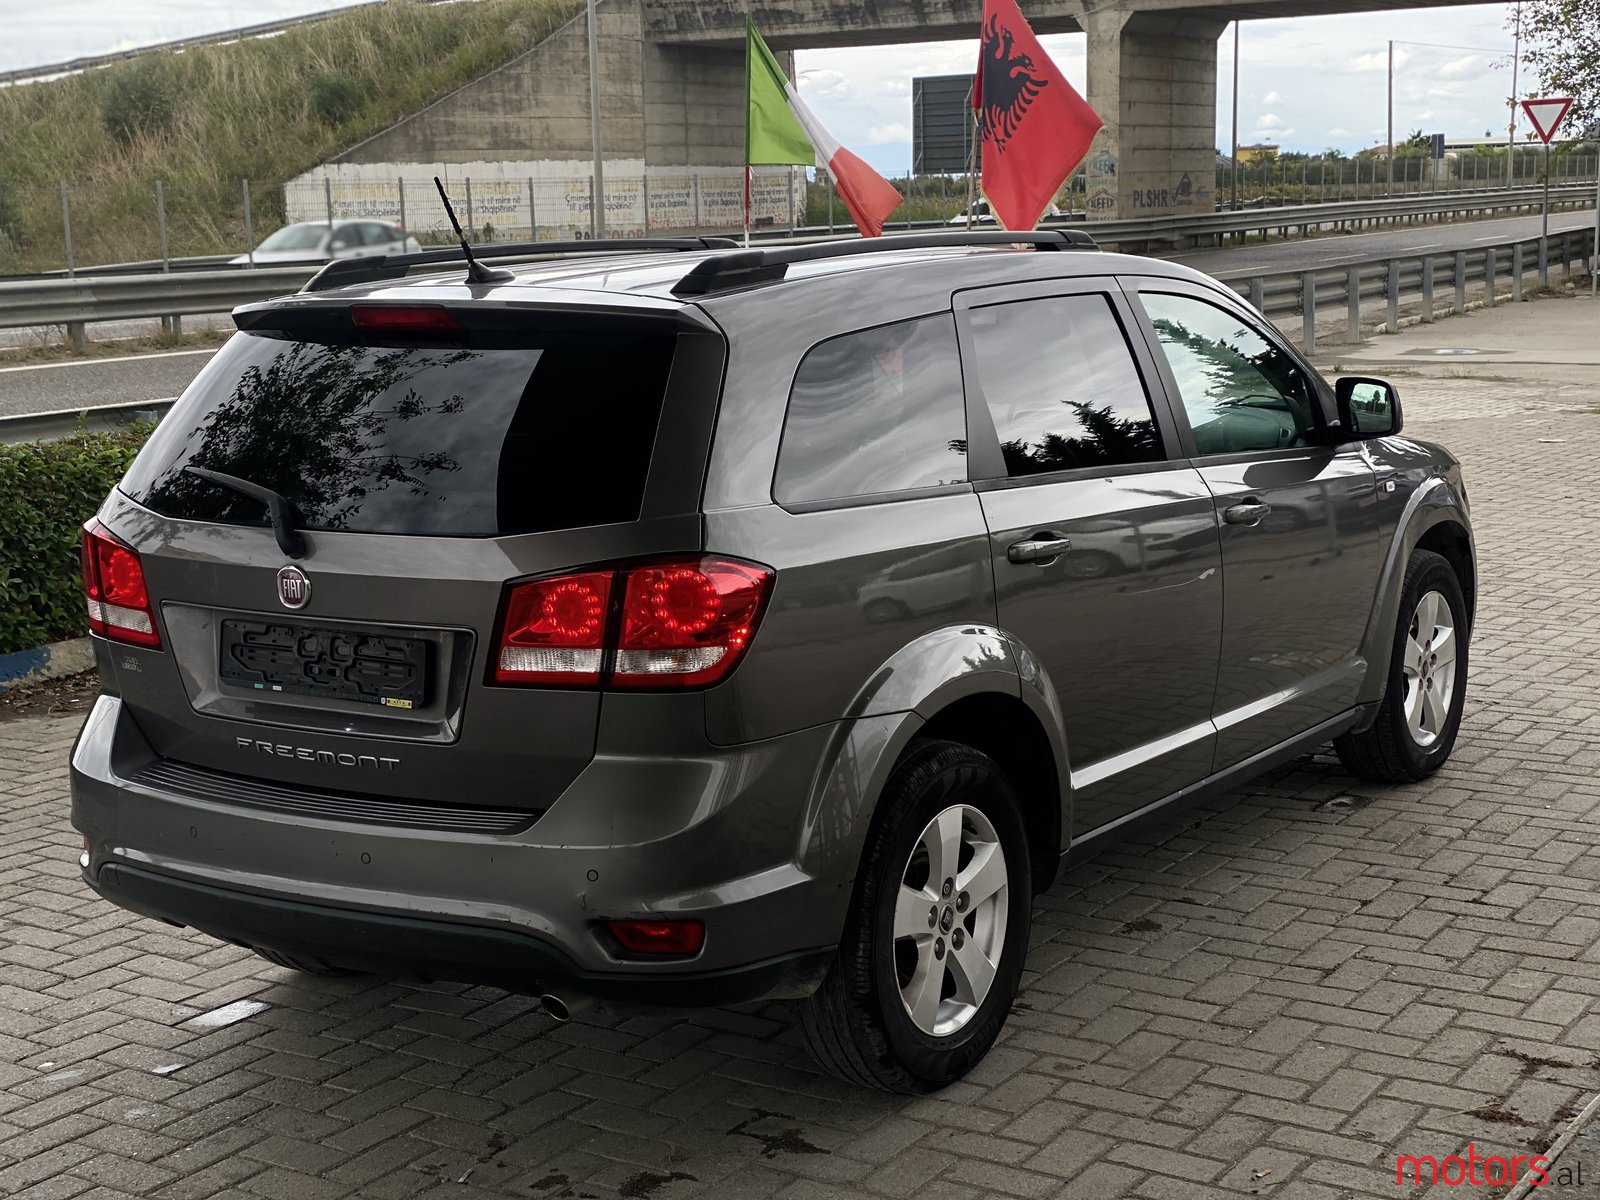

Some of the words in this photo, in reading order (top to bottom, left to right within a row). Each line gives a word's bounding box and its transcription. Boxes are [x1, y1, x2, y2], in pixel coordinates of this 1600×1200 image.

[1132, 189, 1168, 208] PLSHR
[282, 578, 302, 599] FIAT
[236, 737, 400, 771] FREEMONT
